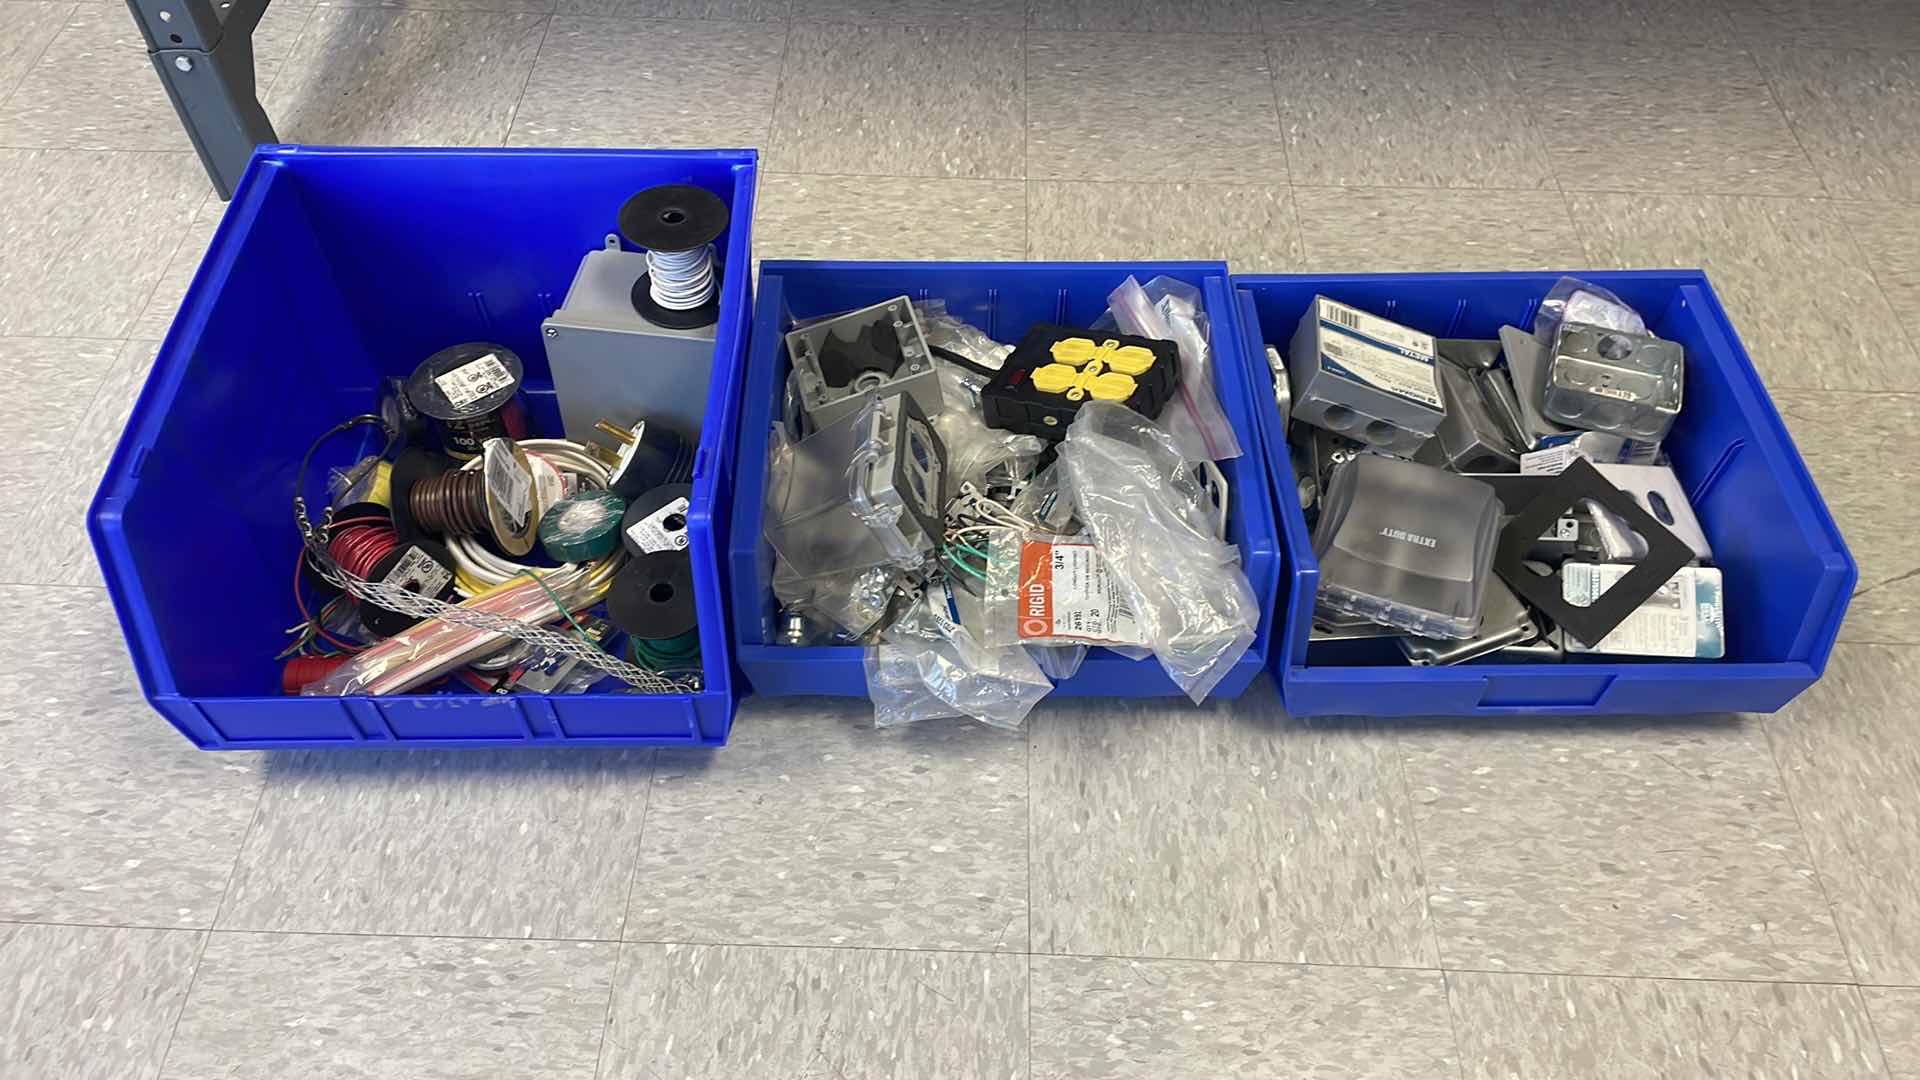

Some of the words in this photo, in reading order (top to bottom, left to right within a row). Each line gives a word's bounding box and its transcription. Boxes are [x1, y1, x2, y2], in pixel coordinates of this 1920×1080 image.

[1379, 527, 1408, 541] DUTY
[1407, 533, 1437, 549] EXTRA
[1054, 550, 1065, 570] 3/4"
[1029, 583, 1046, 617] RIGID
